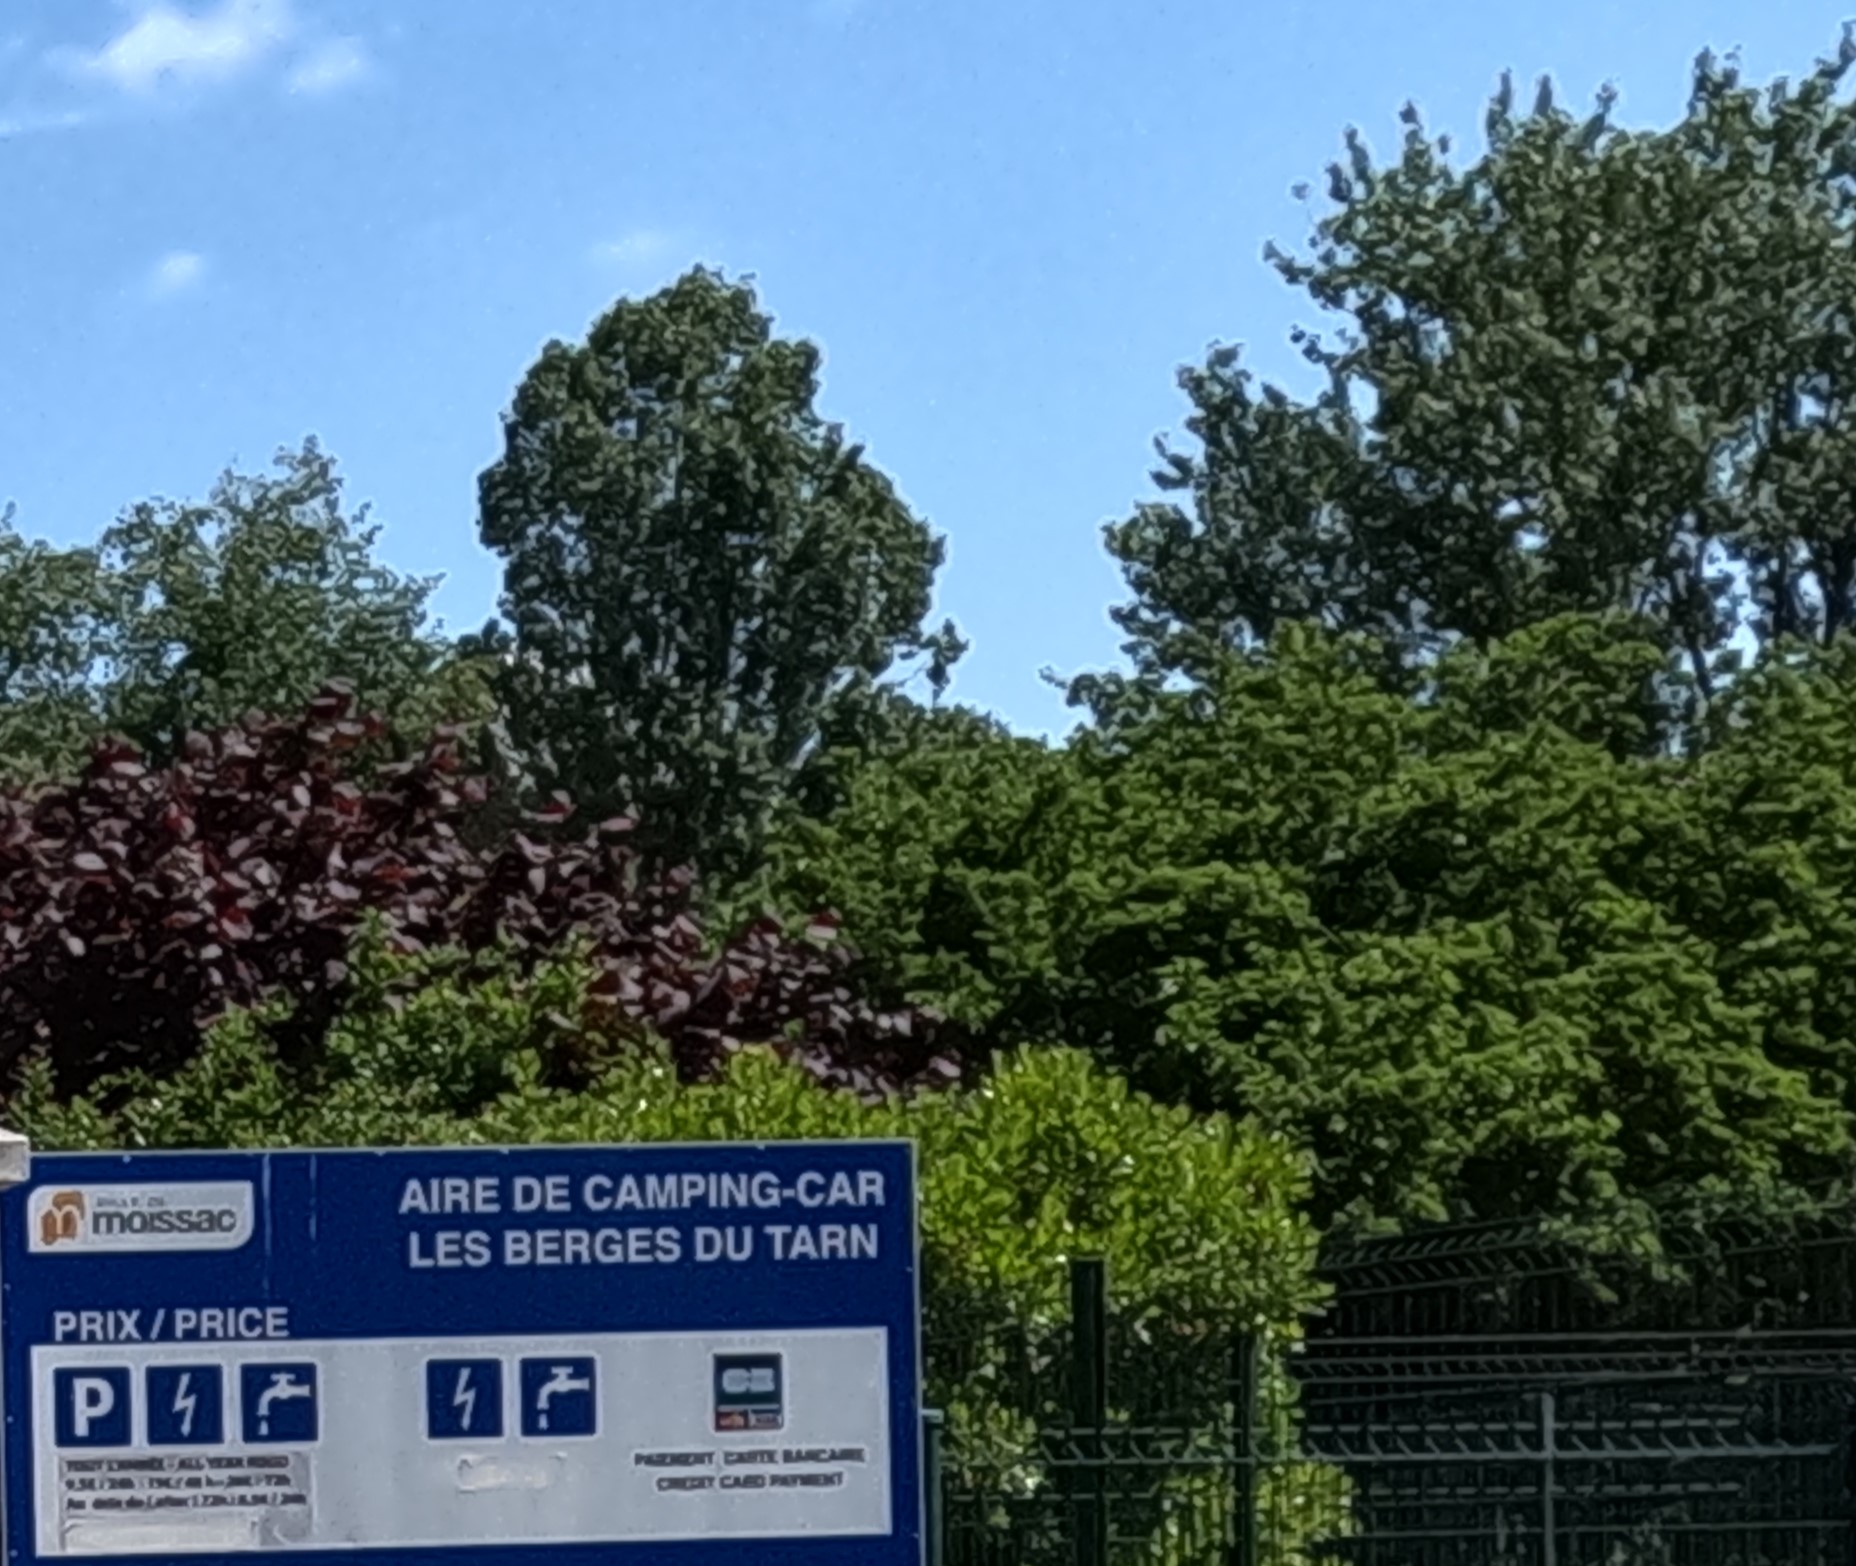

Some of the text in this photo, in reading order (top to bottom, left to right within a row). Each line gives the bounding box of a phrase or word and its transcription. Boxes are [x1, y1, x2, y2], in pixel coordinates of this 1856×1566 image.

[399, 1171, 884, 1213] AIRE DE CAMPING-CAR
[92, 1209, 236, 1234] moissac
[410, 1225, 877, 1267] LES BERGES DU TARN
[55, 1307, 292, 1345] PRIX / PRICE
[73, 1378, 113, 1436] P
